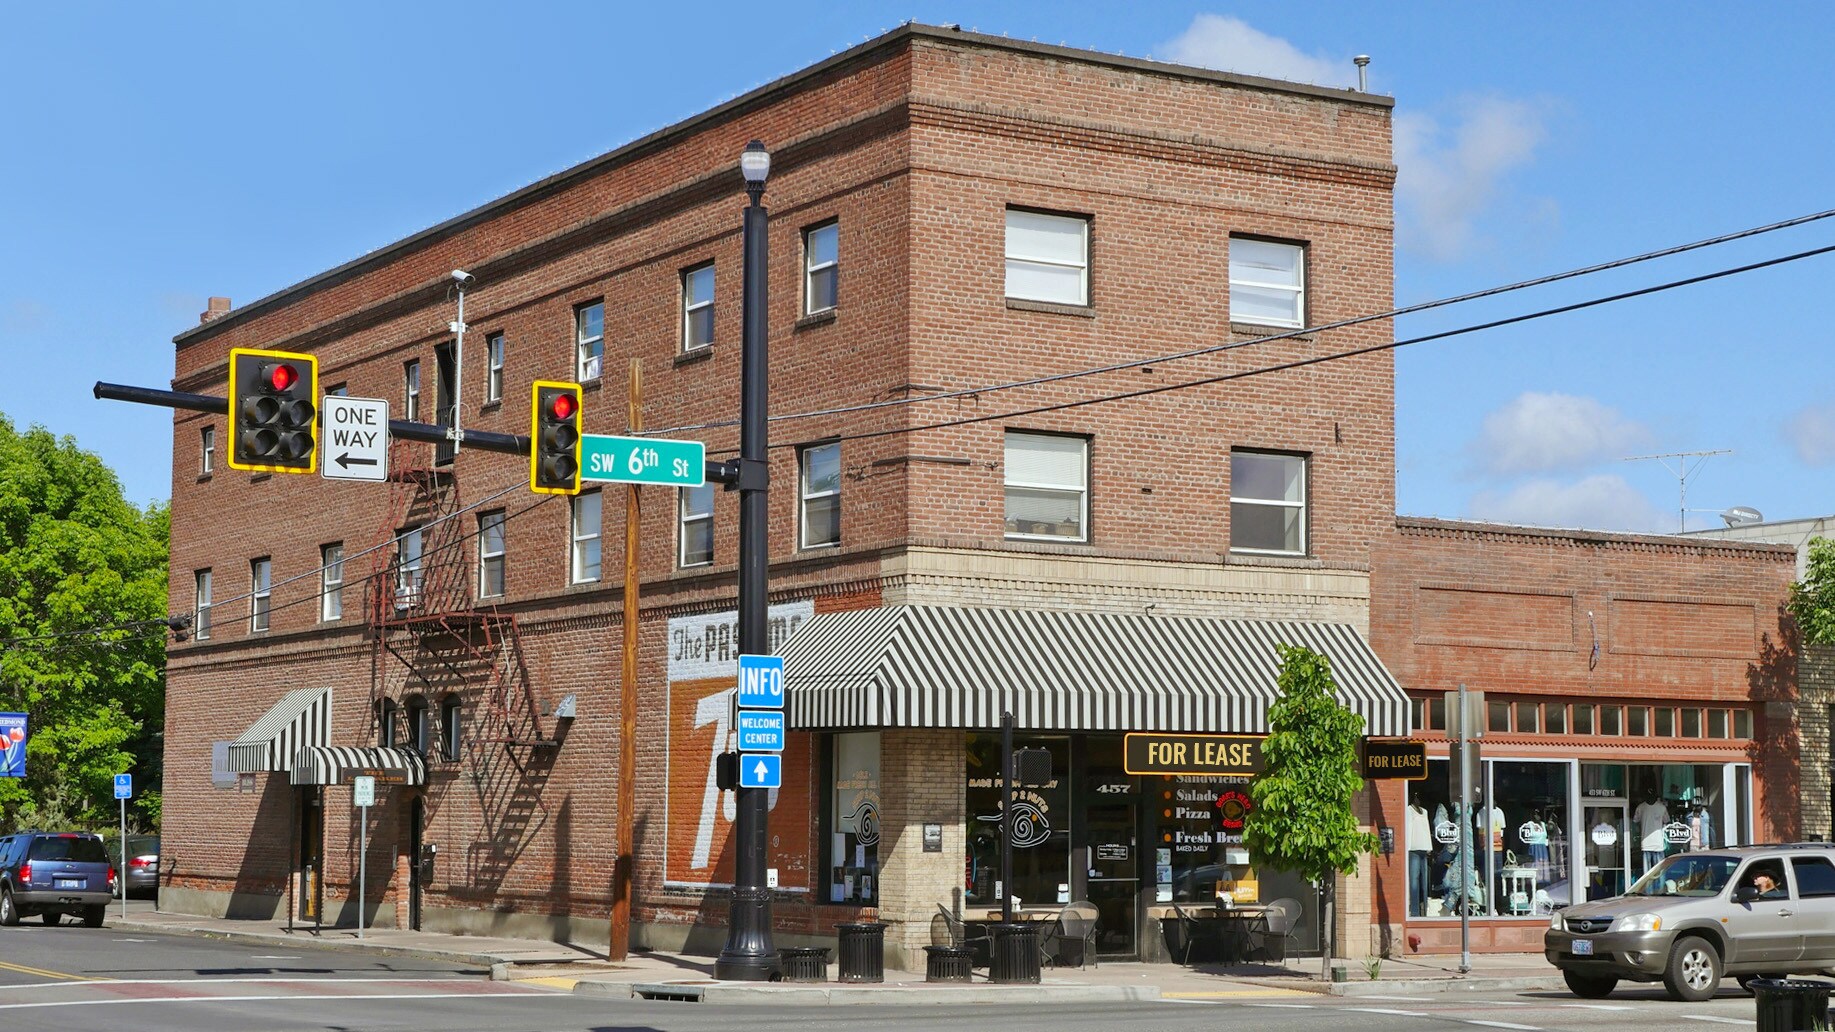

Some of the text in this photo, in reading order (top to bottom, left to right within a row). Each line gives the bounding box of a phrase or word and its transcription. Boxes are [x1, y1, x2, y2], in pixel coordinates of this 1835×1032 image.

[335, 407, 376, 425] ONE
[333, 429, 377, 448] WAY
[590, 447, 689, 478] SW 6th St
[673, 626, 701, 661] The
[741, 667, 782, 696] INFO
[742, 718, 781, 729] WELCOME
[745, 733, 777, 744] CENTER
[1148, 742, 1252, 766] FOR LEASE
[1368, 754, 1422, 768] FOR LEASE
[1176, 775, 1250, 785] Sandwiches
[1096, 784, 1132, 794] 457
[1176, 788, 1218, 802] Salads
[1175, 806, 1211, 819] Pizza
[1175, 831, 1213, 844] Fresh
[1669, 829, 1690, 838] Blvd
